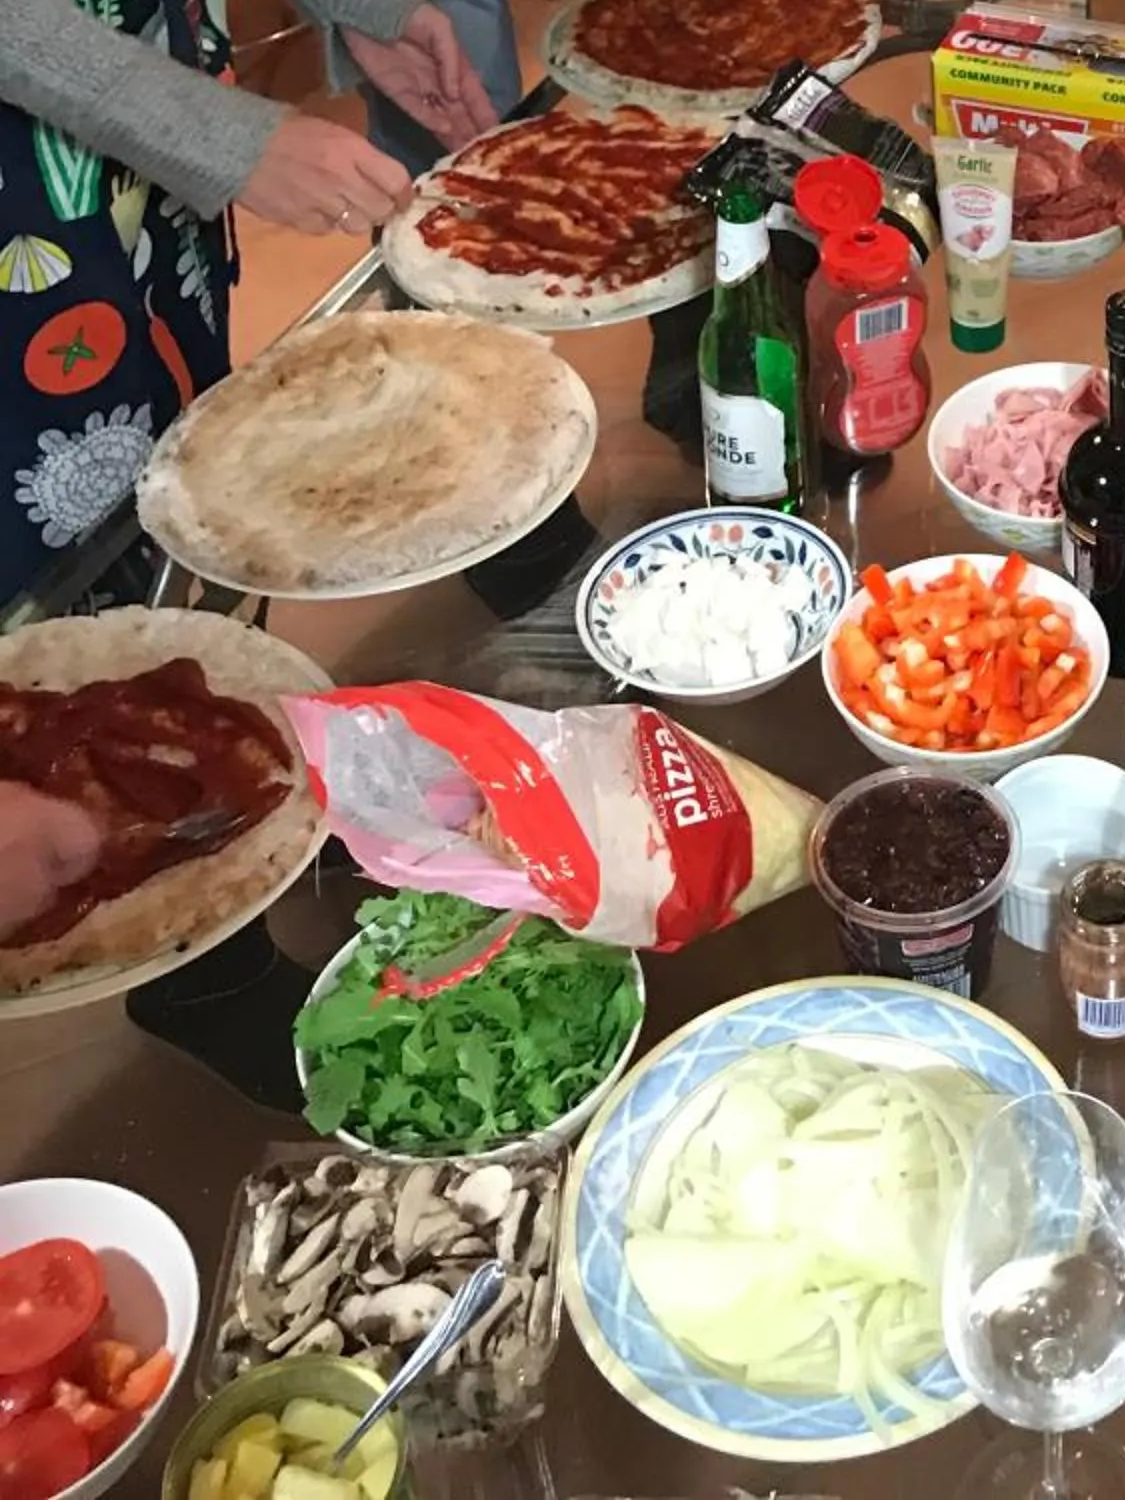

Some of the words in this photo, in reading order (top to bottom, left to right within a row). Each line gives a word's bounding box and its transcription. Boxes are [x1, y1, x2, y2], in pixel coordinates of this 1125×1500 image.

[950, 68, 1031, 89] COMMUNITY
[1033, 80, 1067, 95] PACK
[956, 155, 993, 174] Garlic
[655, 727, 709, 828] pizza
